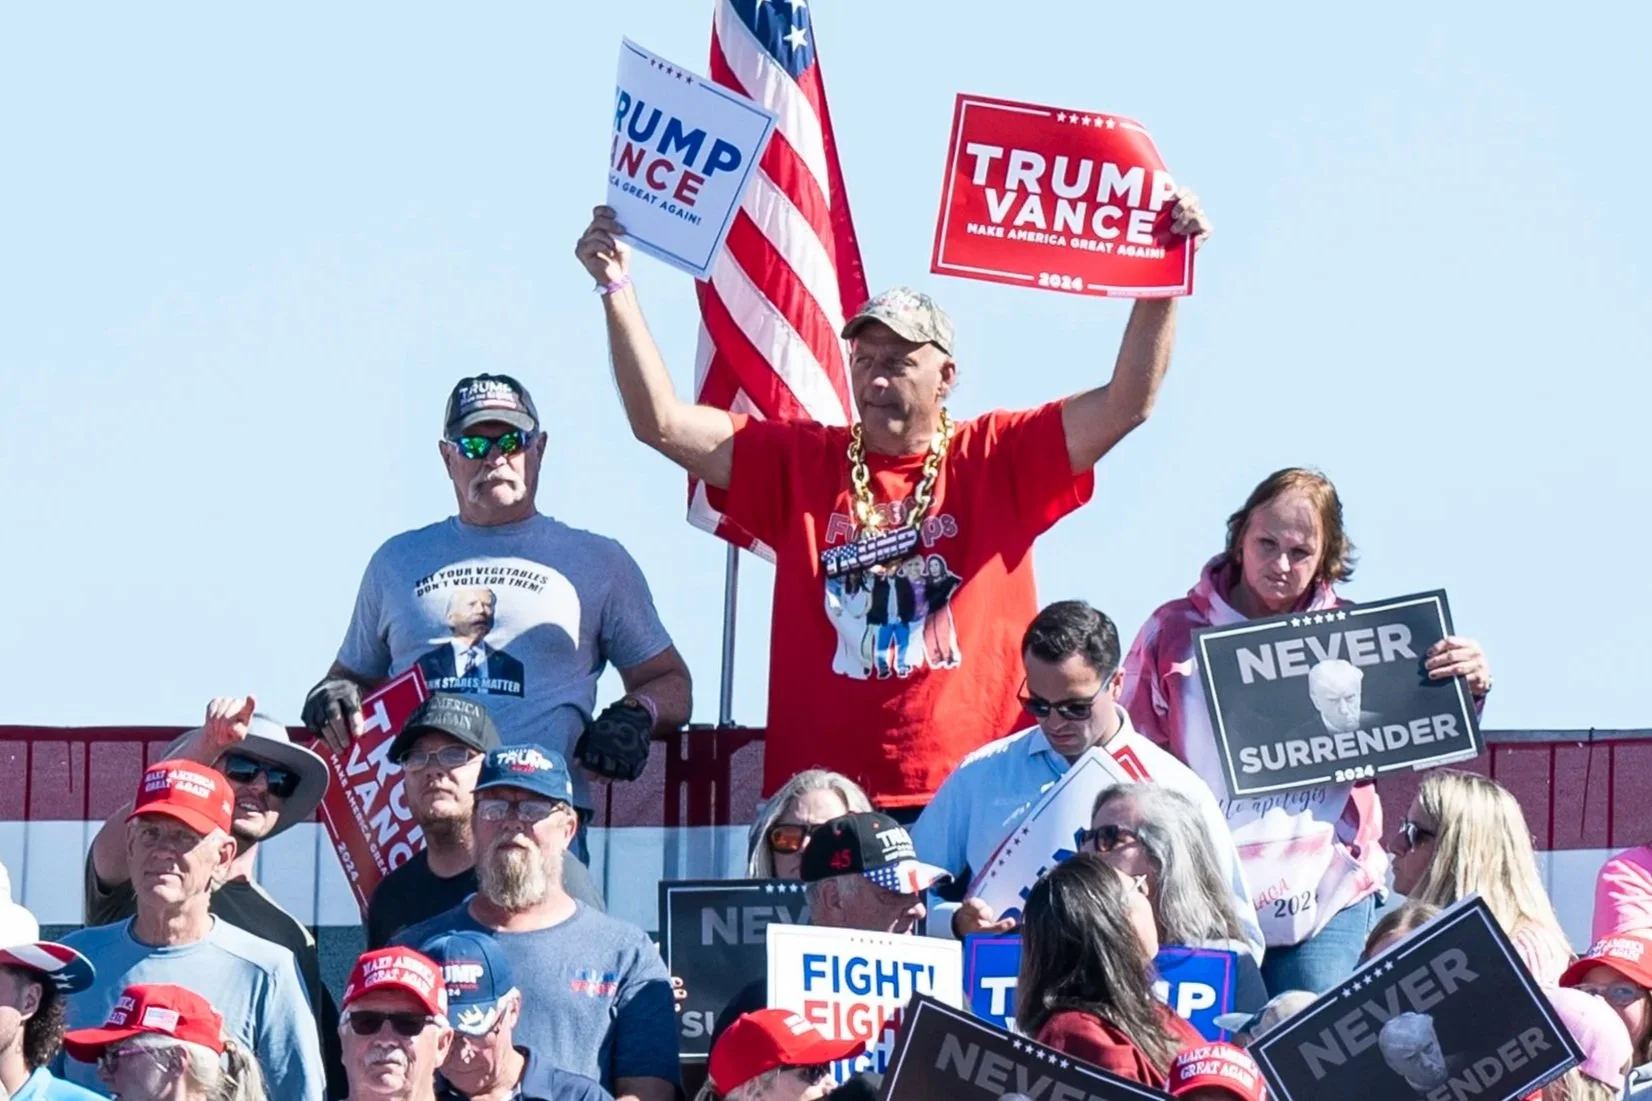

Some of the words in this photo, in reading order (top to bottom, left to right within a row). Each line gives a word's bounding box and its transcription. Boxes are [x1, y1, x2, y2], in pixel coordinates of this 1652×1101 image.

[616, 87, 742, 178] RUMP
[611, 134, 705, 208] NCE
[966, 142, 1178, 211] TRUMP
[622, 182, 658, 205] GREAT
[659, 200, 703, 227] AGAIN!
[984, 187, 1158, 245] VANCE
[967, 222, 1005, 239] MAKE
[1007, 229, 1067, 248] AMERICA
[1070, 237, 1115, 255] GREAT
[1116, 244, 1166, 260] AGAIN!
[1037, 272, 1084, 291] 2024
[416, 580, 449, 597] DON'T
[453, 576, 481, 586] VOTE
[484, 576, 505, 585] FOR
[508, 578, 545, 595] THEM!
[439, 568, 472, 580] YOUR
[476, 566, 549, 585] VEGETABLES
[1236, 622, 1418, 685] NEVER
[481, 678, 522, 693] MATTER
[1239, 712, 1460, 775] SURRENDER
[1334, 763, 1375, 783] 2024
[330, 753, 349, 788] MAKE
[345, 789, 372, 842] AMERICA
[369, 842, 388, 876] GREA
[345, 742, 413, 871] VANC
[337, 841, 360, 882] 2024
[831, 849, 852, 869] 45
[1273, 890, 1319, 918] 202
[802, 953, 935, 999] FIGHT!
[804, 1000, 901, 1043] FIGH
[1297, 947, 1480, 1081] NEVER
[1177, 1047, 1212, 1067] MAKE
[1180, 1060, 1220, 1080] GREAT
